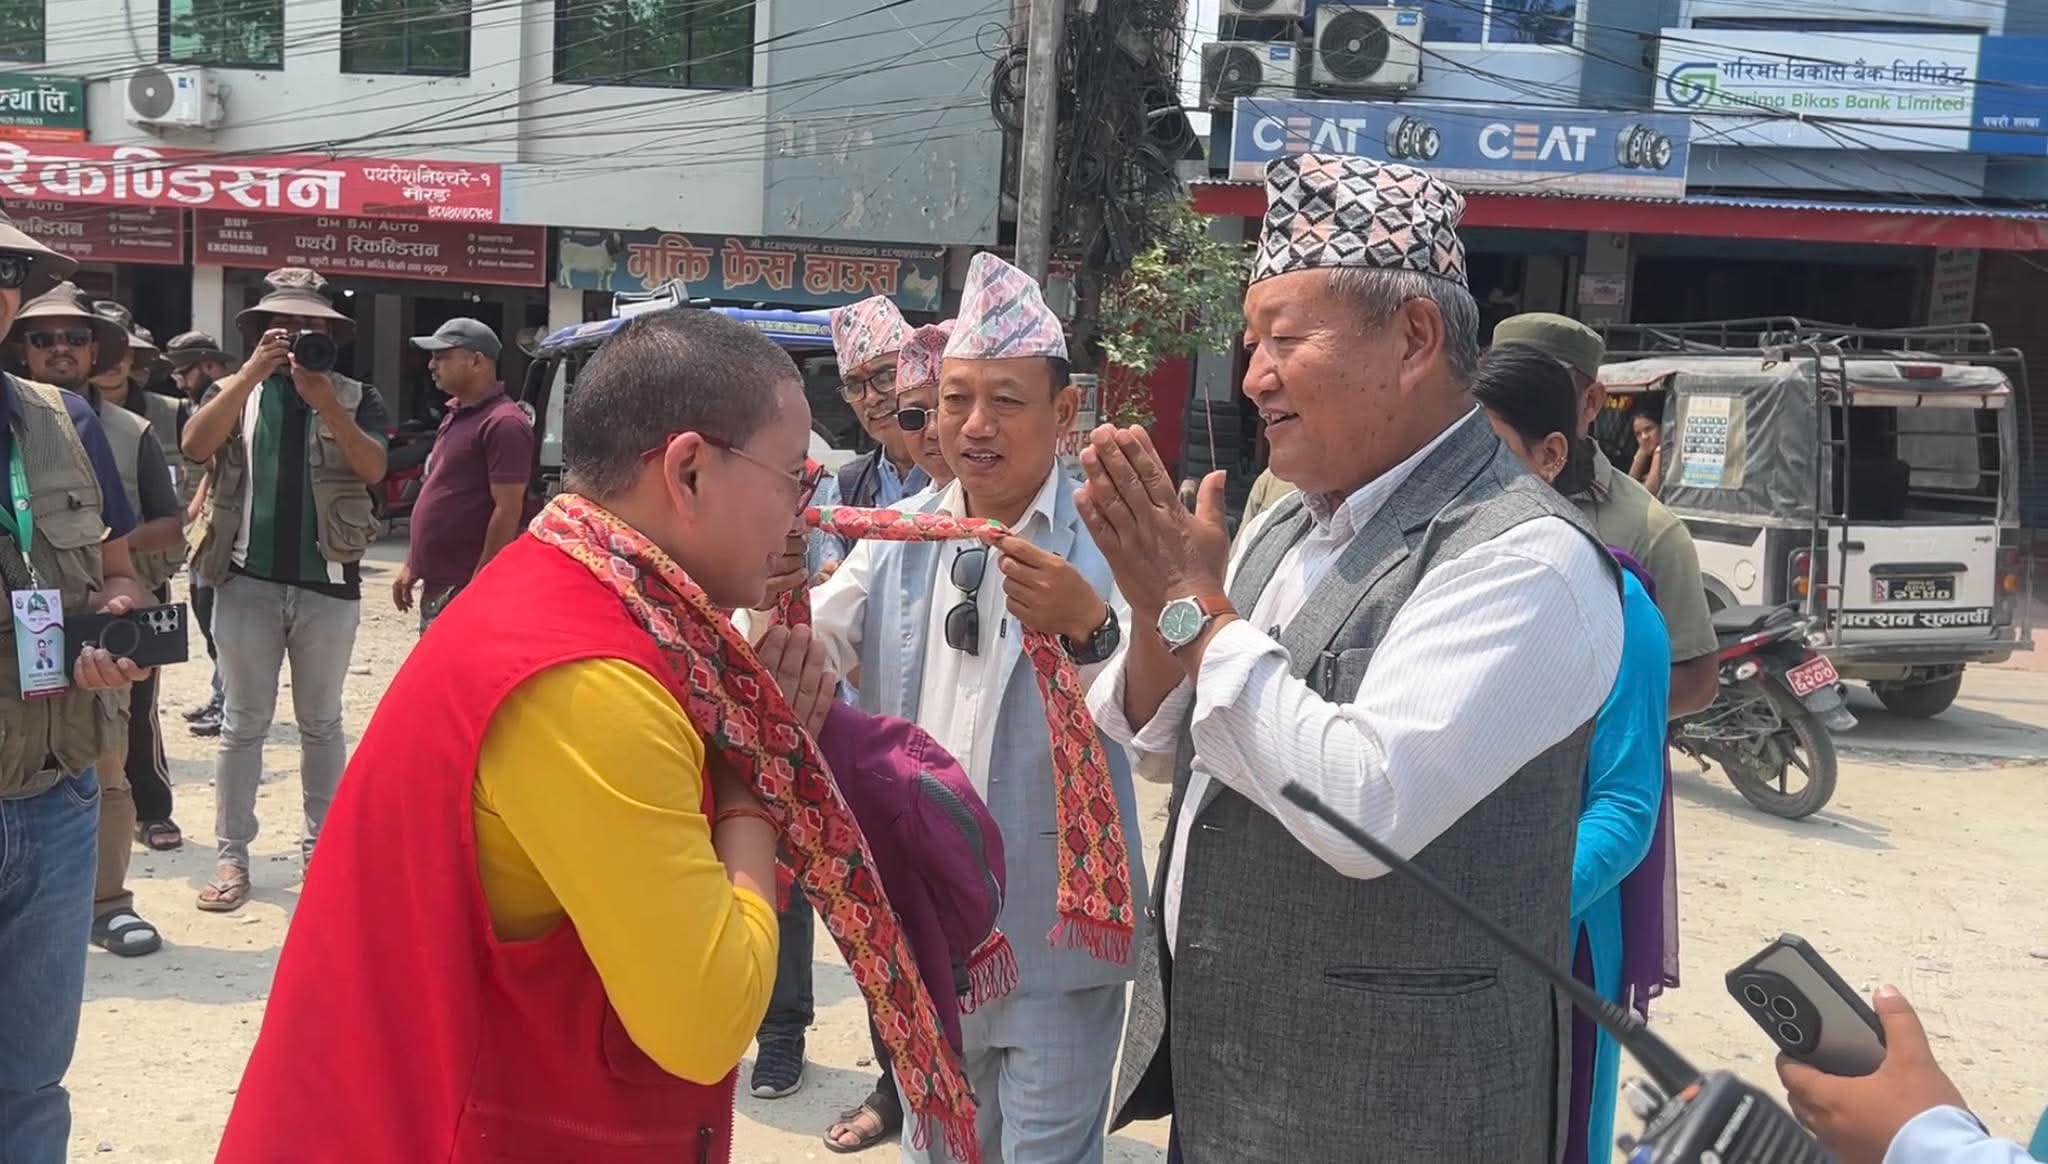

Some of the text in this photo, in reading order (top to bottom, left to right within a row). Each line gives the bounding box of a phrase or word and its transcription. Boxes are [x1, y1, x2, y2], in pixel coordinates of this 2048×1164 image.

[1722, 56, 1967, 86] गरिमा विकास बैंक लिमिटेड
[1791, 93, 1839, 108] Bikas
[1846, 95, 1890, 110] Bank
[1897, 95, 1967, 111] Limited
[1252, 117, 1367, 154] CEAT
[1478, 123, 1597, 161] CEAT
[379, 220, 419, 233] AUTO
[207, 242, 268, 256] EXCHANGE
[295, 234, 336, 252] पथरी
[628, 234, 713, 290] मुक्ति
[803, 254, 901, 296] हाउस
